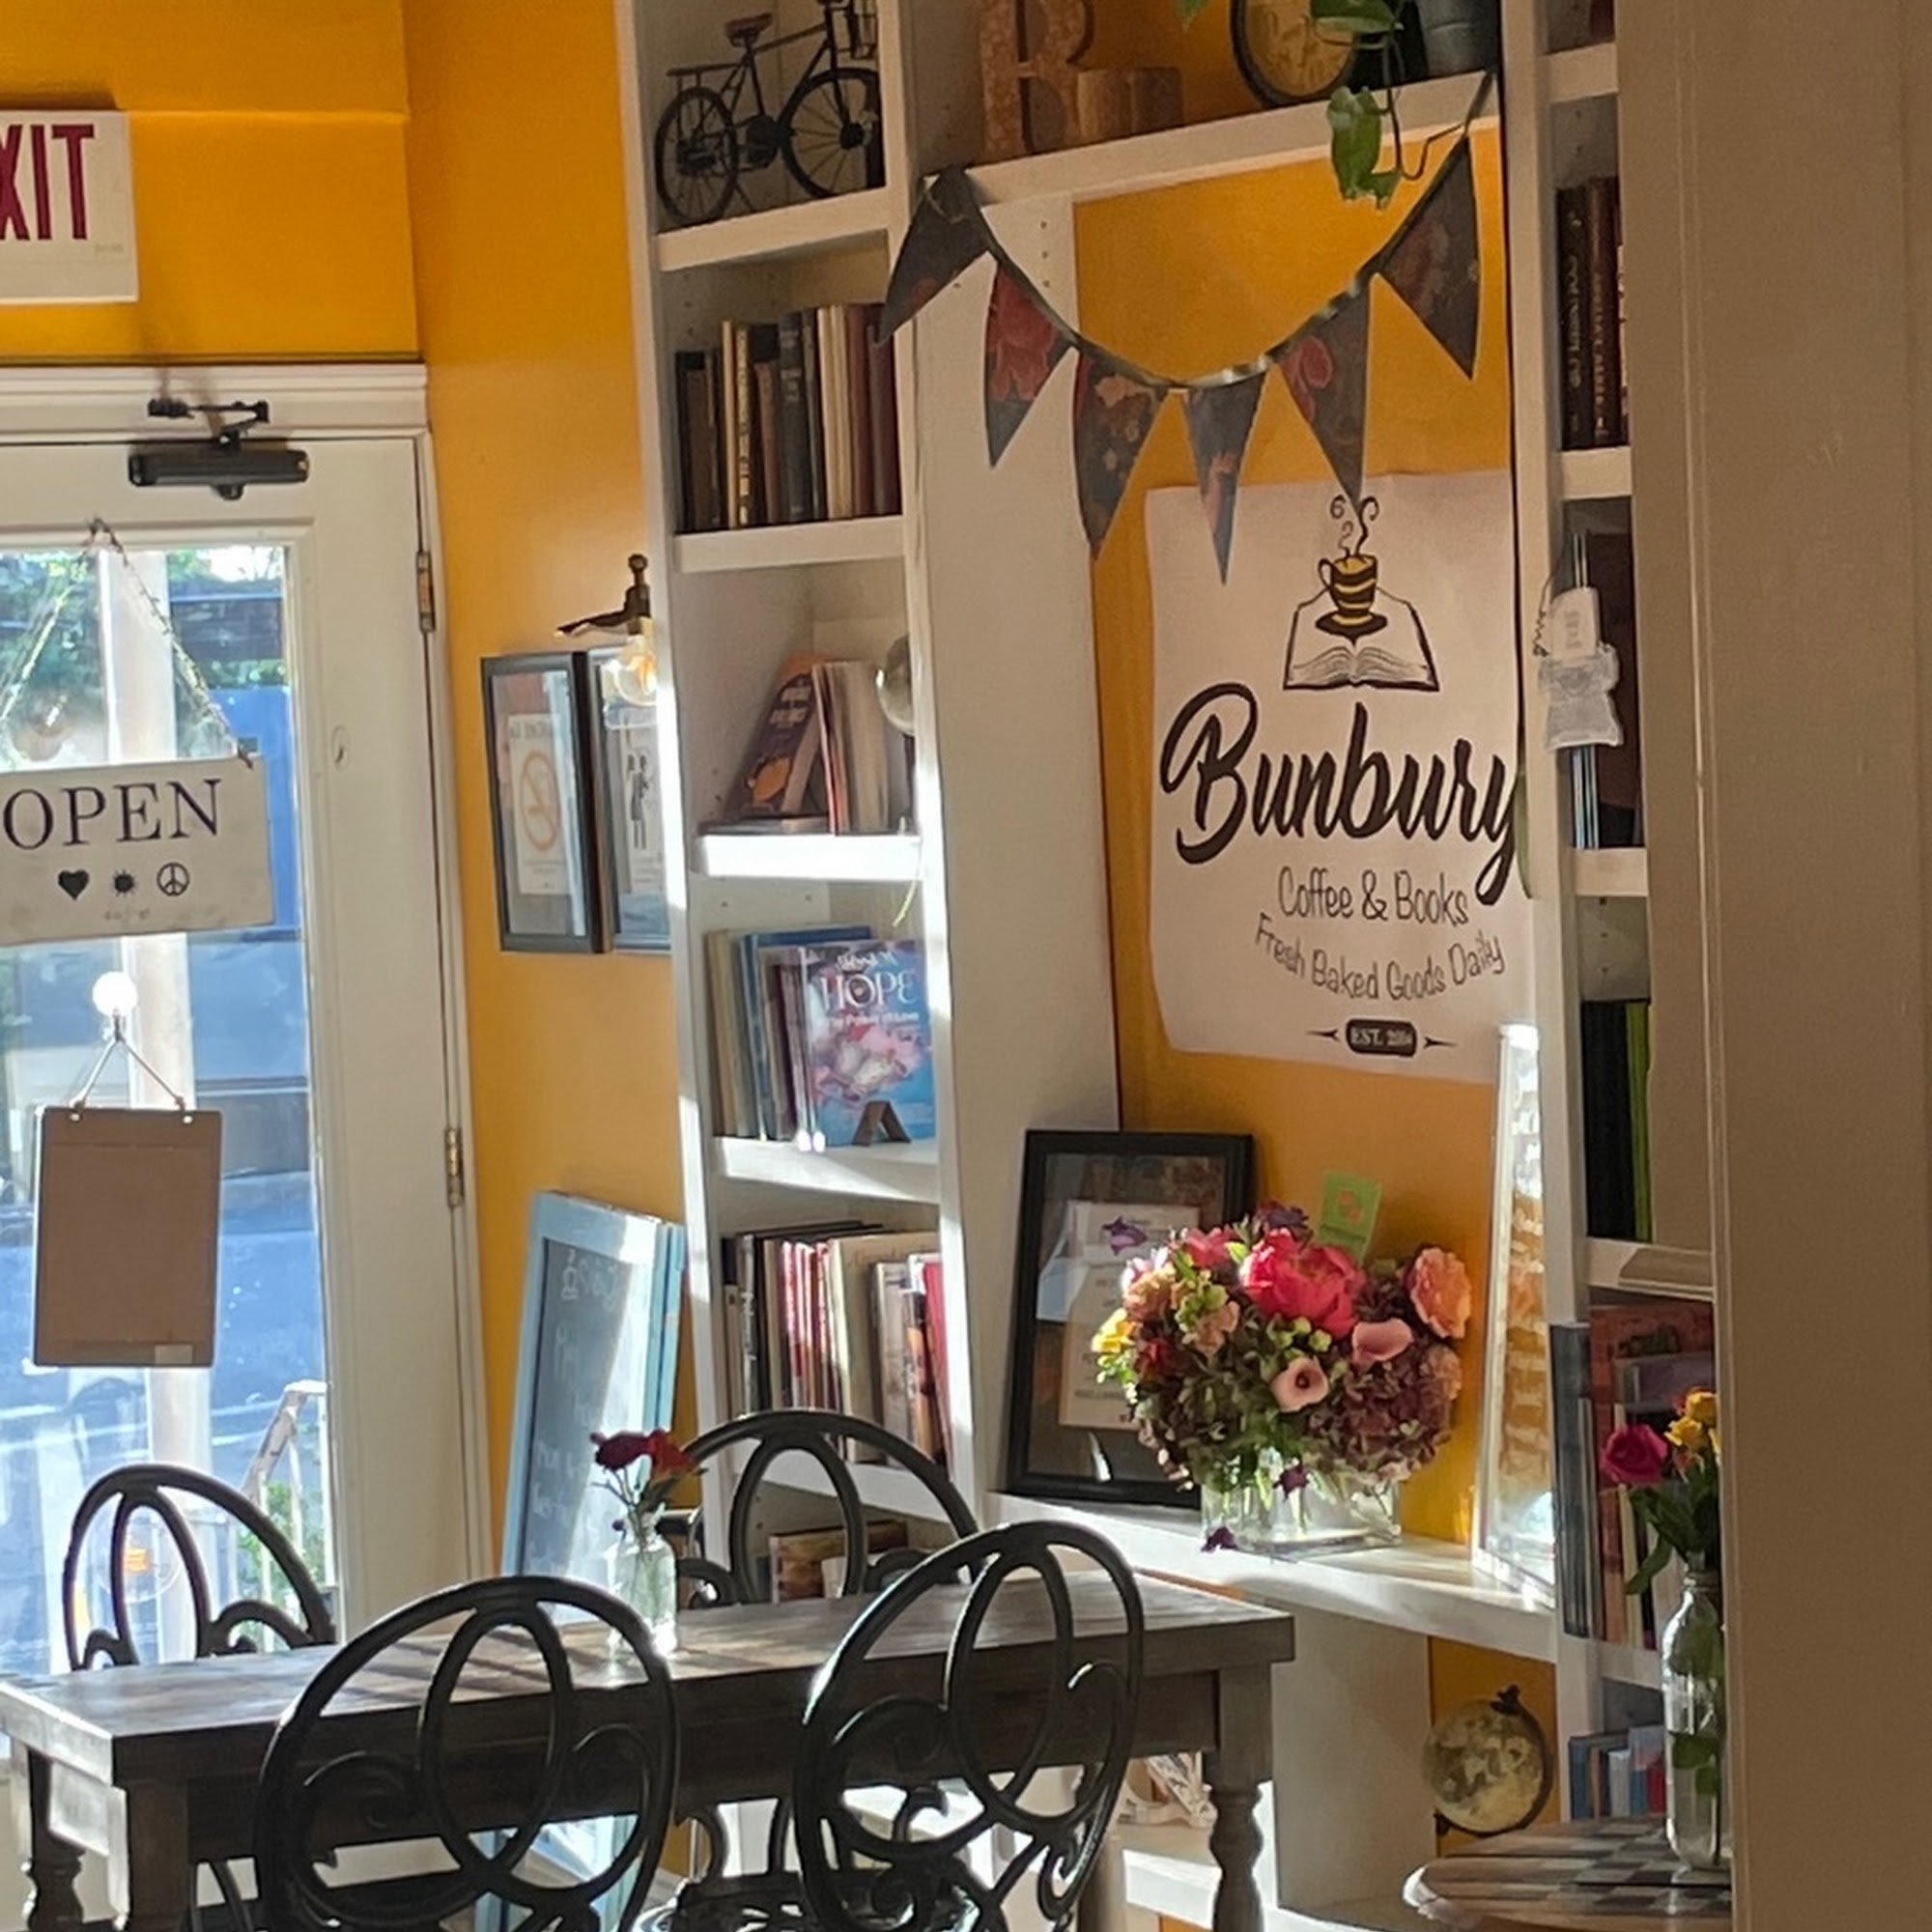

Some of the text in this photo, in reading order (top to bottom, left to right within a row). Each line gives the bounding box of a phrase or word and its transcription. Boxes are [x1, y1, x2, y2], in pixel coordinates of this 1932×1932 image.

[3, 779, 222, 850] OPEN
[1160, 683, 1517, 906] Bunbury
[1278, 866, 1469, 927] Coffee & Books
[820, 970, 921, 1010] HOPE
[1255, 912, 1506, 1002] Fresh Baked Goods Daily
